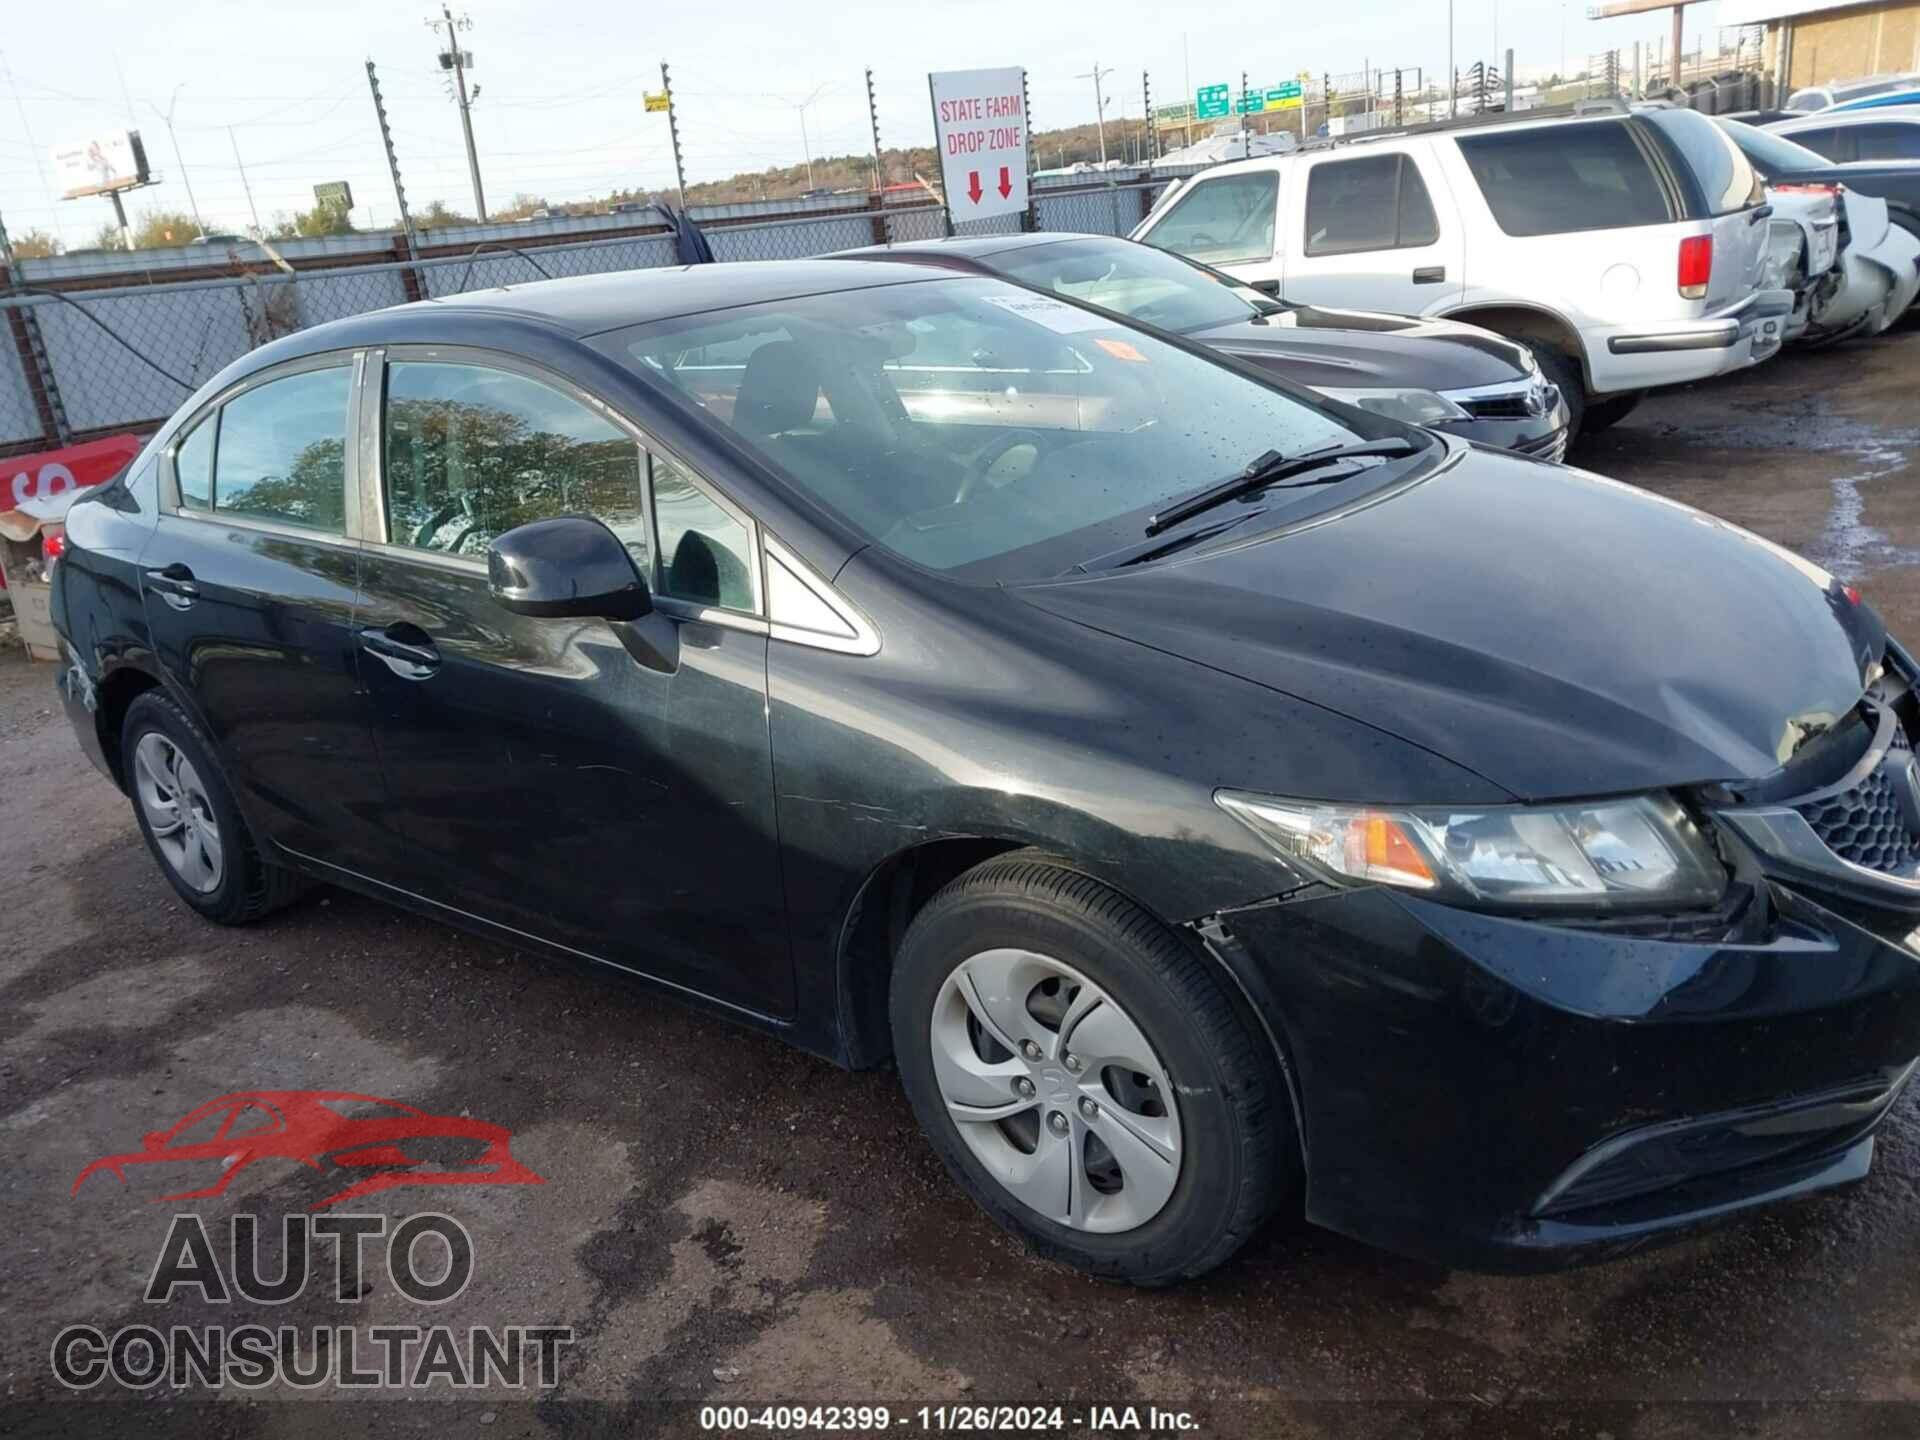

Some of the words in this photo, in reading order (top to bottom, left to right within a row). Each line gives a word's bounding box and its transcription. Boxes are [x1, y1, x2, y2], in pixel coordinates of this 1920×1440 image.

[940, 98, 982, 122] STATE
[986, 95, 1021, 118] FARM
[947, 131, 985, 155] DROP
[989, 127, 1021, 150] ZONE
